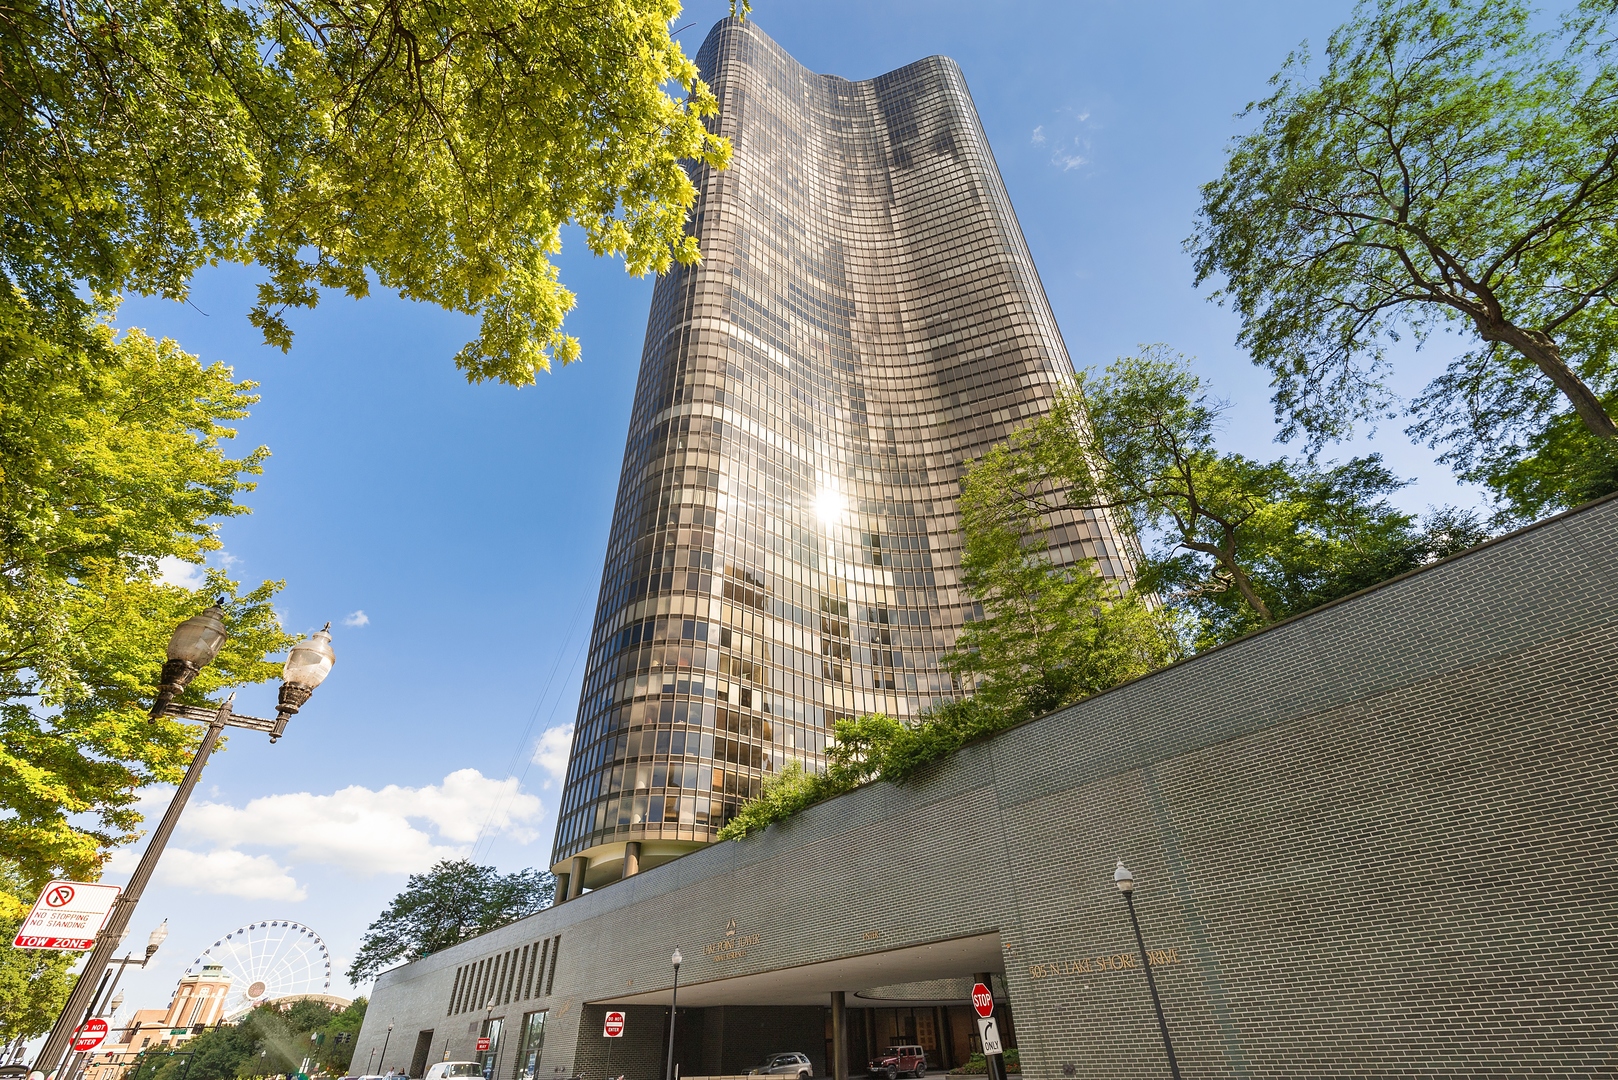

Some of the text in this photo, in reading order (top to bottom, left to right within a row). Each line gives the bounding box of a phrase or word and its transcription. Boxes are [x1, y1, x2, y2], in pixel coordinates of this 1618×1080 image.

[34, 911, 89, 921] NO STOPPING
[30, 919, 86, 929] NO STANDING
[20, 937, 88, 948] TOW ZONE
[738, 933, 760, 947] TOWER
[1029, 964, 1047, 979] 505
[1064, 958, 1093, 975] LAKE
[1096, 953, 1138, 972] SHORE
[974, 993, 991, 1007] STOP
[985, 1040, 999, 1051] ONLY
